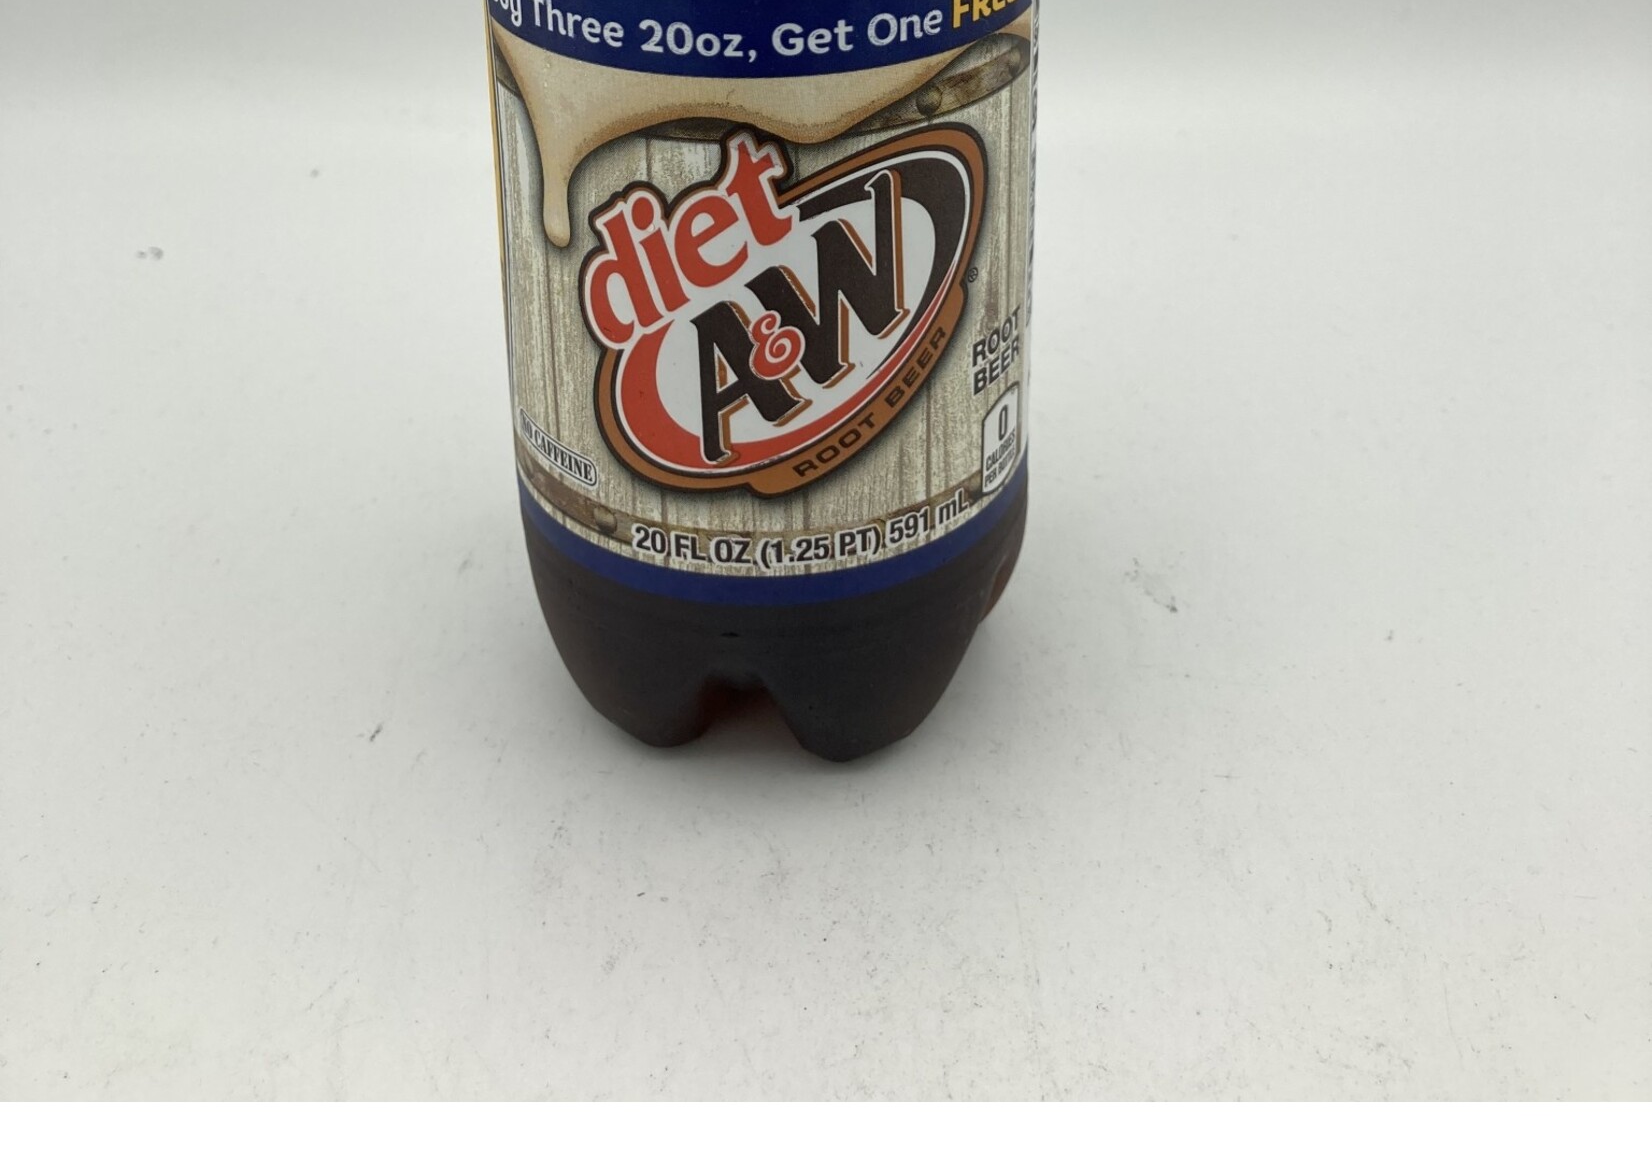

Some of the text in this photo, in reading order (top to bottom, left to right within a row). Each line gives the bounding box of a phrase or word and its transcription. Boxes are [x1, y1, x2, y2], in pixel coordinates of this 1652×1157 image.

[638, 18, 757, 63] 20oz,
[771, 18, 853, 56] Get
[867, 9, 943, 46] One
[589, 139, 793, 345] diet
[690, 168, 911, 466] A&W
[972, 305, 1021, 367] ROOT
[973, 334, 1020, 396] BEER
[792, 325, 947, 478] ROOT BEER
[998, 404, 1008, 442] 0
[534, 428, 594, 482] CAFFEINE
[634, 489, 968, 569] 20 FL OZ (1.25 PT) 591 mL
